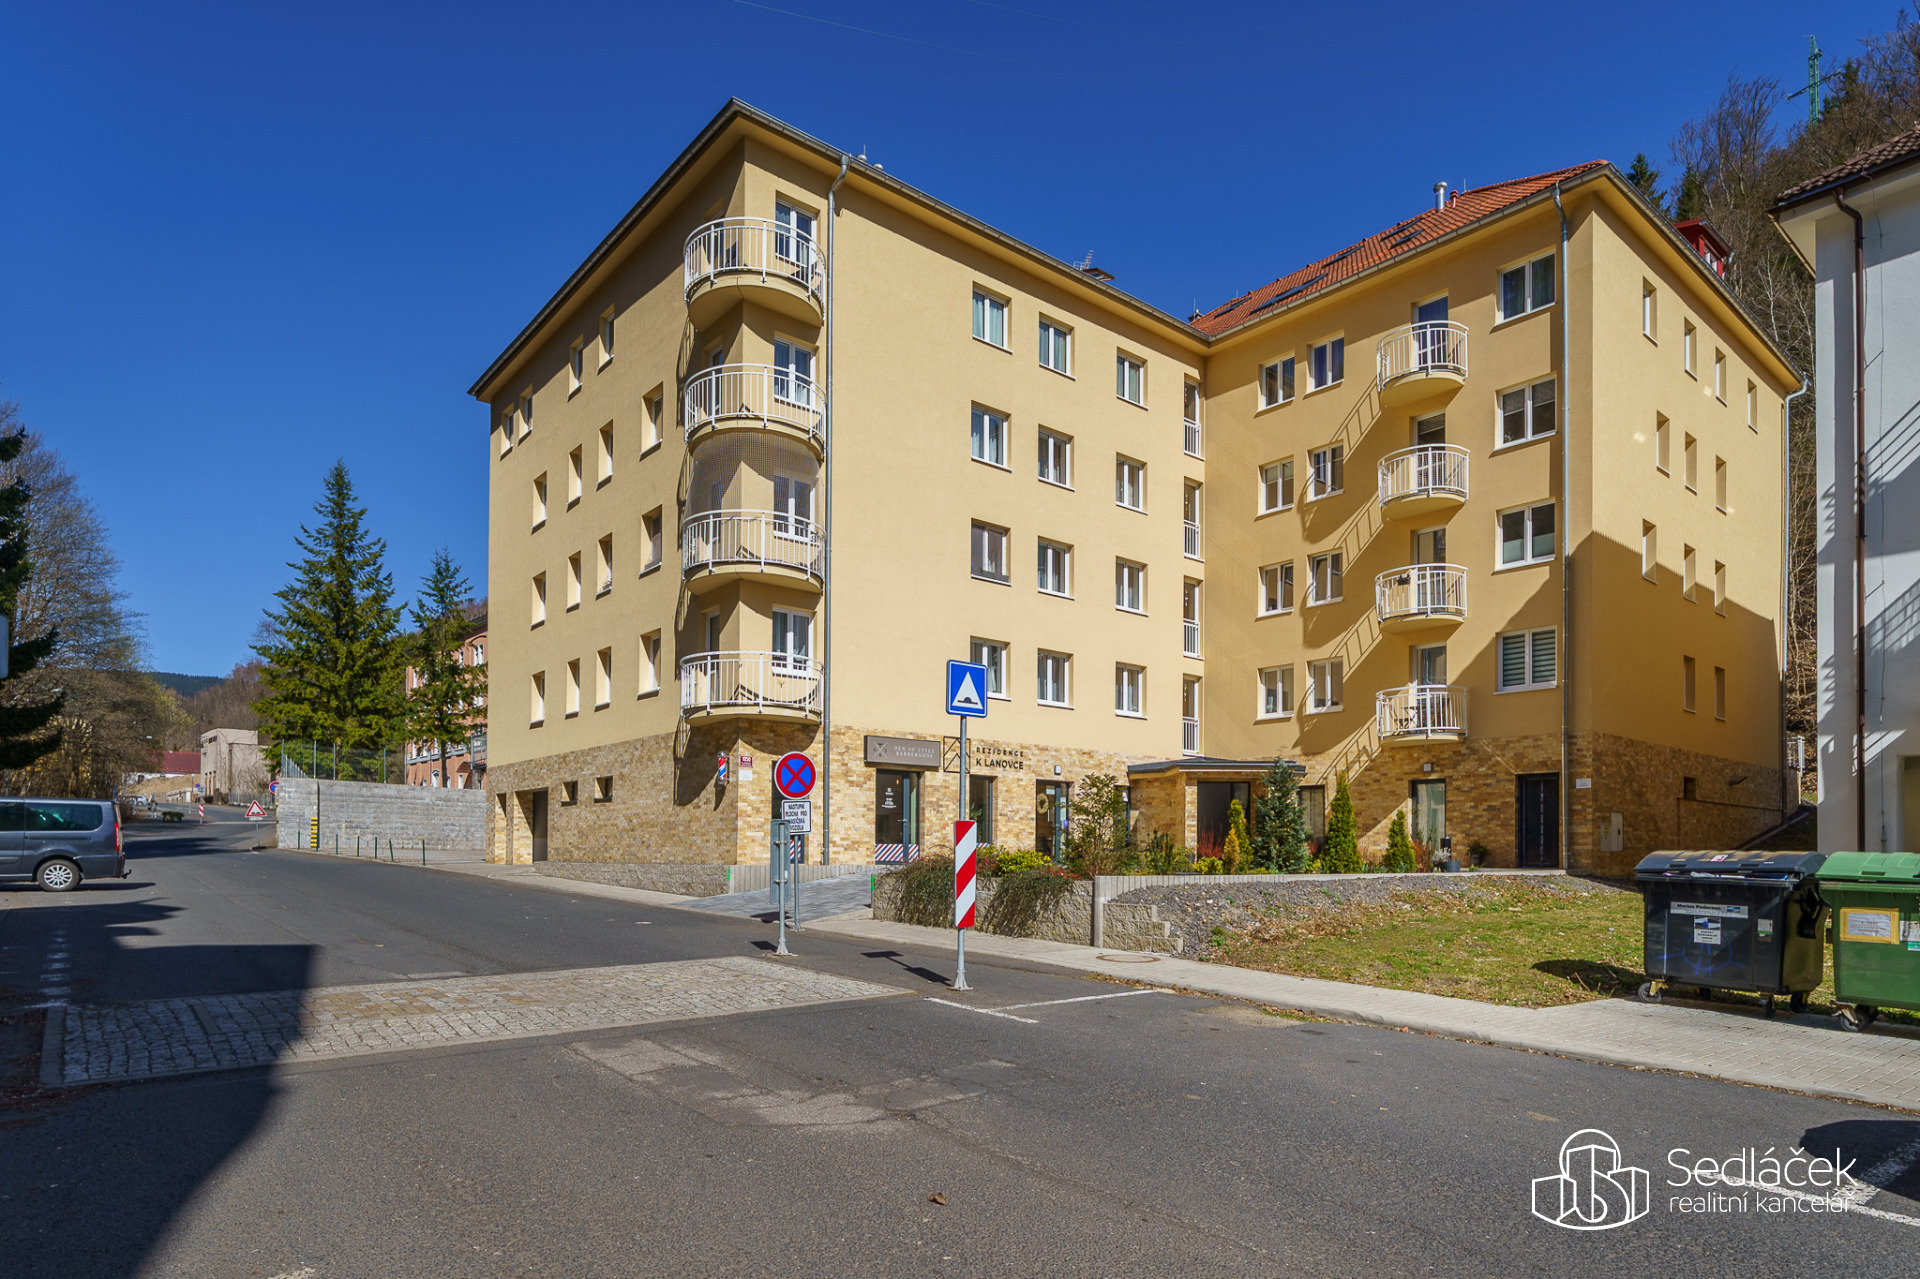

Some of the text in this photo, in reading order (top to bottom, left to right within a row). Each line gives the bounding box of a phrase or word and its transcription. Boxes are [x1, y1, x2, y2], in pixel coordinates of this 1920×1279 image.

[895, 751, 934, 759] BARBERSHOP
[976, 747, 1024, 757] REZIDENCE
[976, 758, 1024, 770] K LANOVCE
